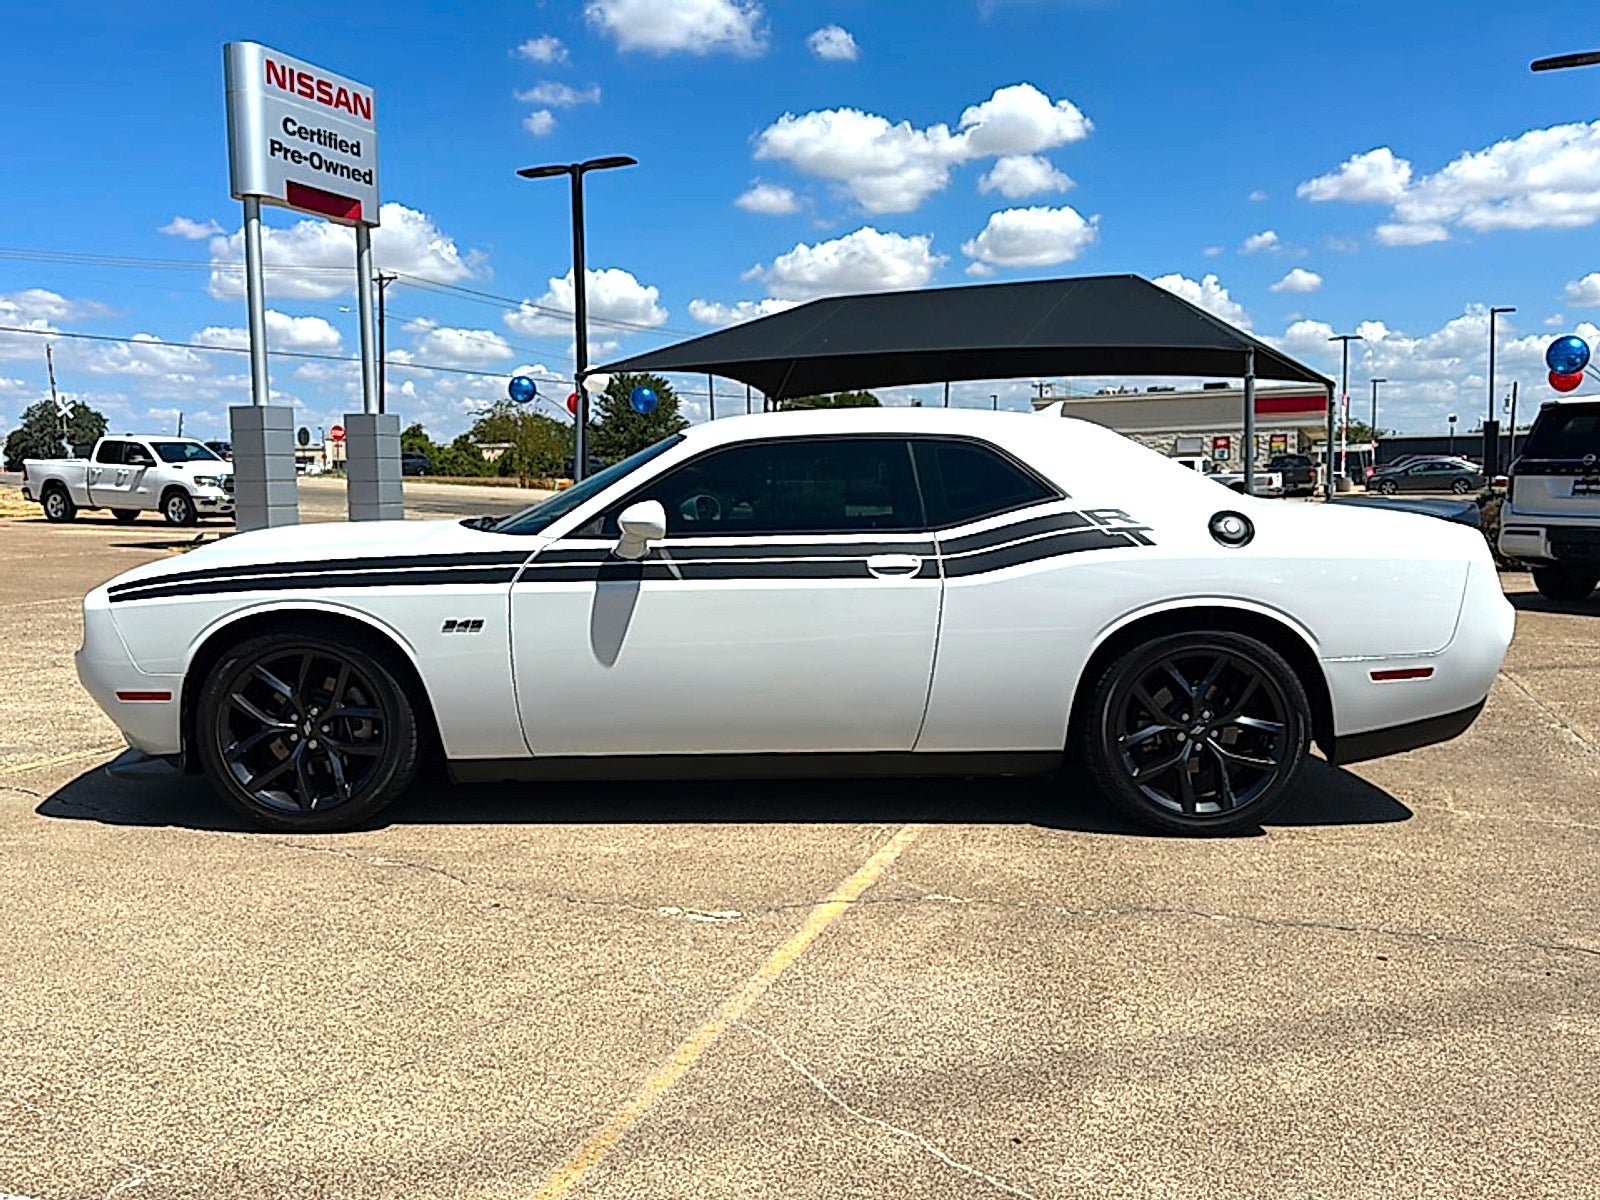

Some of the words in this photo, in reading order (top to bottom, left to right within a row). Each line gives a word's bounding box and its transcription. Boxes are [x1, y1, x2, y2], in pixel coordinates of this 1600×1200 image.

[265, 59, 372, 121] NISSAN
[282, 117, 362, 158] Certified
[269, 138, 373, 186] Pre-Owned
